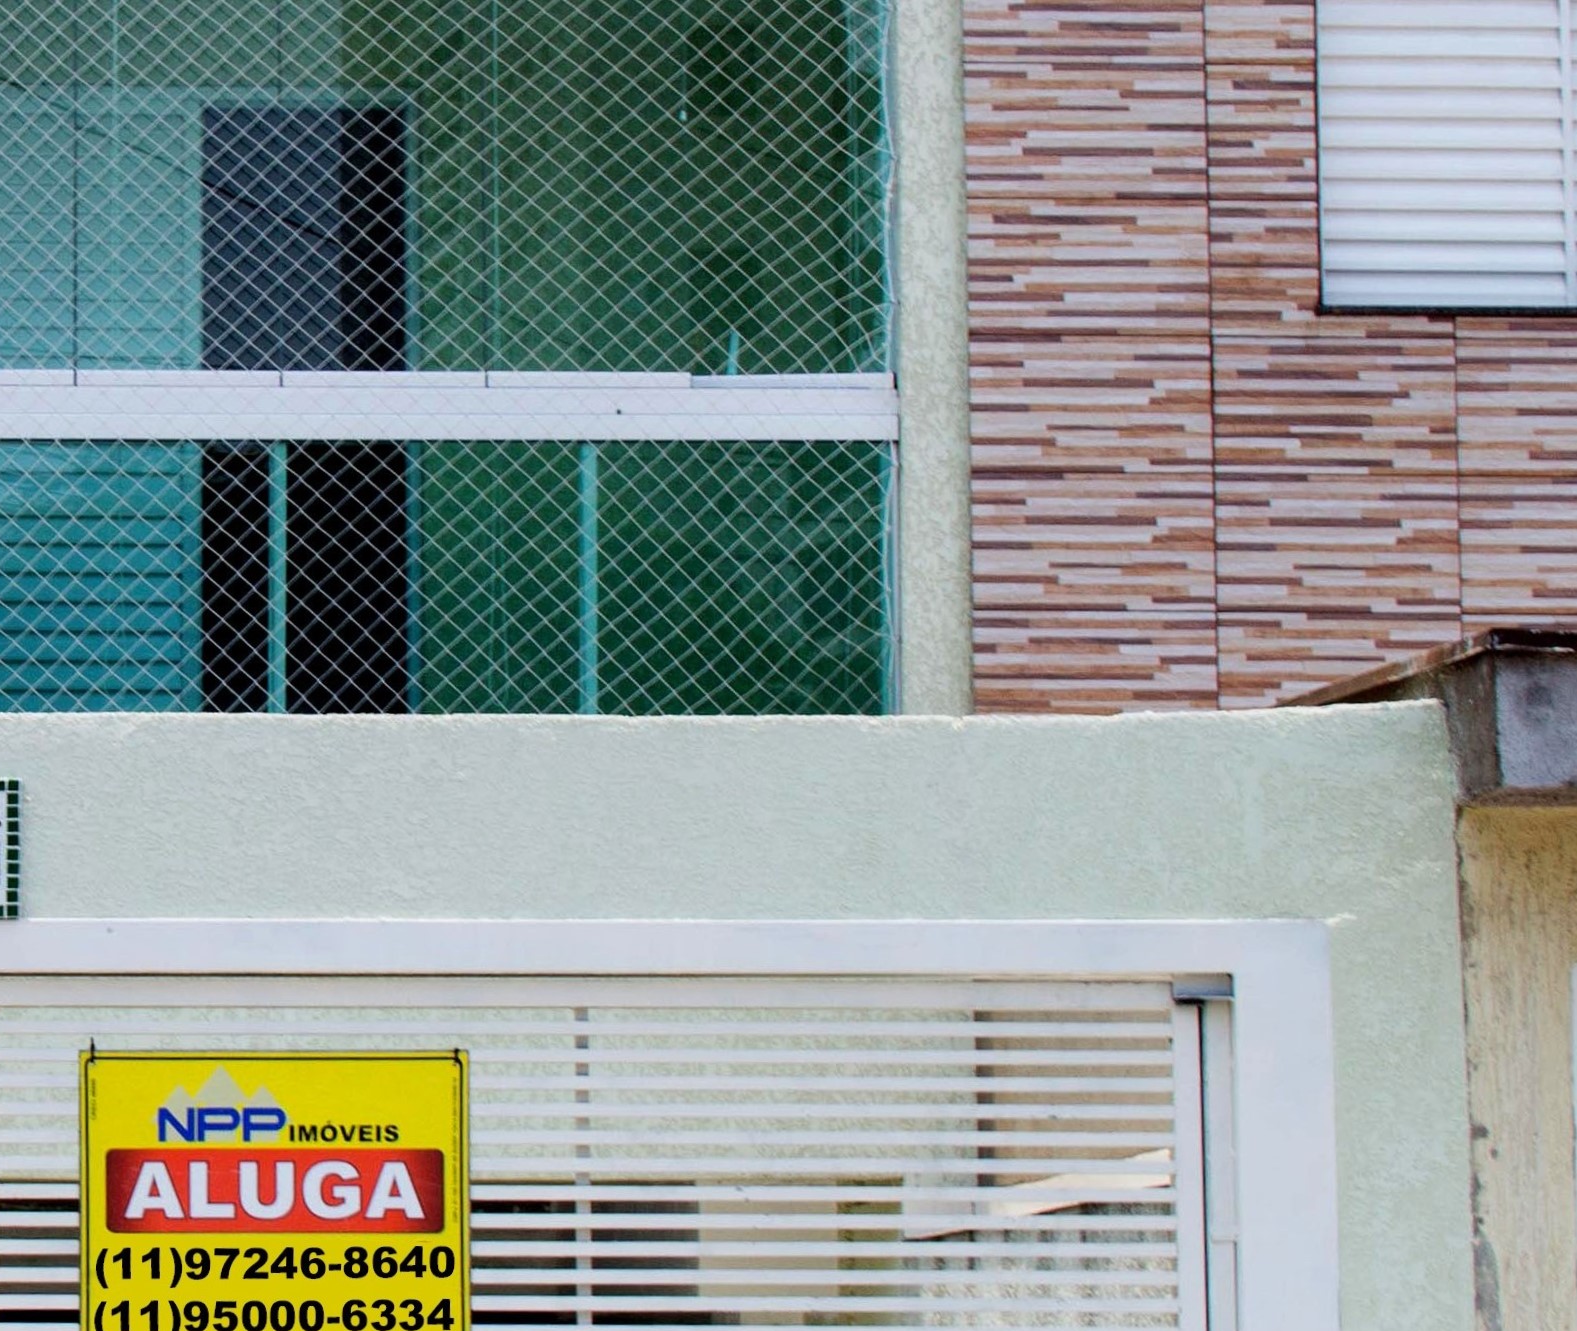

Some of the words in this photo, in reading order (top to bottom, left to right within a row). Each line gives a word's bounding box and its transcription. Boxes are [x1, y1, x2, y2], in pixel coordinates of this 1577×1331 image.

[157, 1107, 287, 1143] NPP
[288, 1121, 400, 1143] IMÓVEIS
[124, 1160, 426, 1221] ALUGA
[95, 1245, 456, 1288] (11)97246-8640
